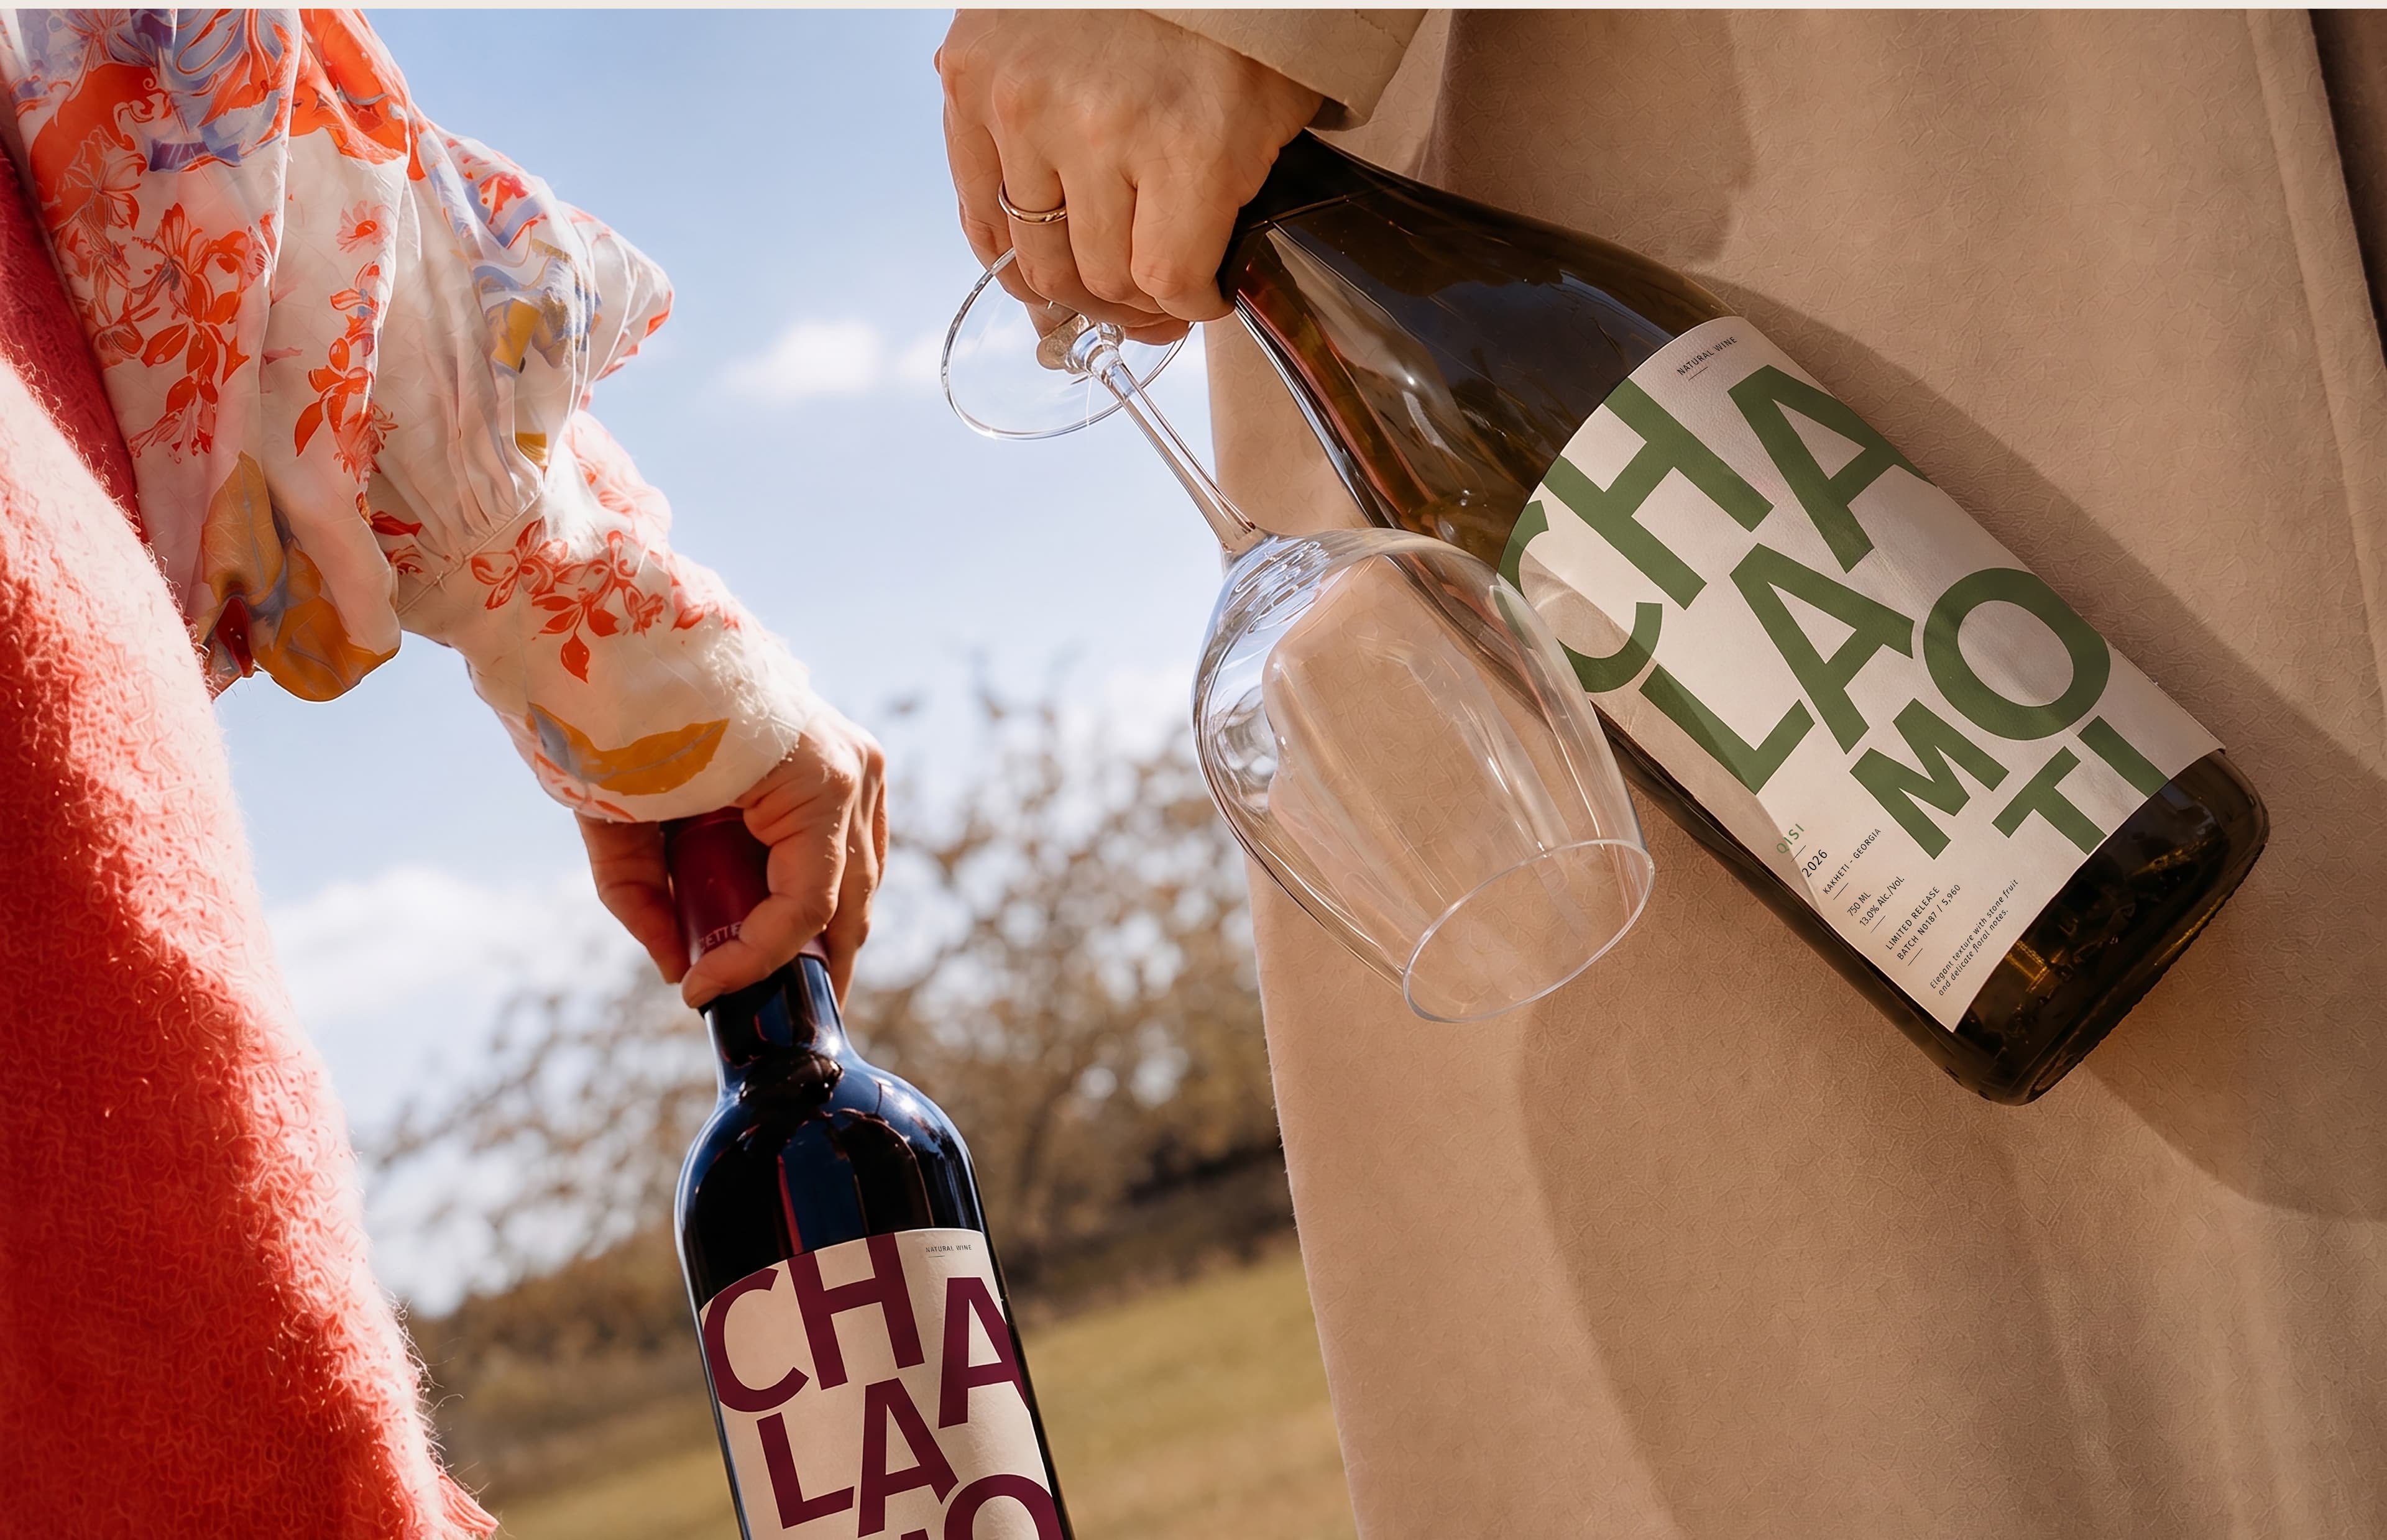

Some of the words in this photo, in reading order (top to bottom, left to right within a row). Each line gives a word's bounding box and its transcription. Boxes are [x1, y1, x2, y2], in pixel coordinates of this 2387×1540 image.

[1676, 350, 1714, 375] NATURAL
[1713, 337, 1737, 352] WINE
[1493, 364, 1938, 693] CHA
[1639, 543, 1915, 795] LA
[1849, 567, 2111, 859] MO
[1992, 715, 2171, 855] TI
[1776, 823, 1805, 854] QISI
[1801, 849, 1828, 878] 2026
[1823, 864, 1850, 894] KAKHETI
[1853, 828, 1881, 859] GEORGIA
[1847, 902, 1860, 916] 750
[1858, 892, 1871, 904] ML
[1859, 905, 1880, 926] 13.0%
[1877, 876, 1905, 906] Alc./Vol.
[1885, 919, 1913, 950] LIMITED
[1911, 886, 1940, 919] RELEASE
[1897, 936, 1919, 960] BATCH
[1941, 884, 1961, 906] 5,960
[1930, 961, 1954, 989] Elegant
[1952, 935, 1974, 961] texture
[1973, 918, 1987, 935] with
[1987, 897, 2004, 918] stone
[2002, 879, 2018, 898] fruit
[1939, 980, 1951, 996] and
[1951, 951, 1974, 980] delicate
[1973, 931, 1990, 953] floral
[1989, 910, 2008, 931] notes.
[703, 1232, 1030, 1429] CHA
[757, 1377, 959, 1538] LA
